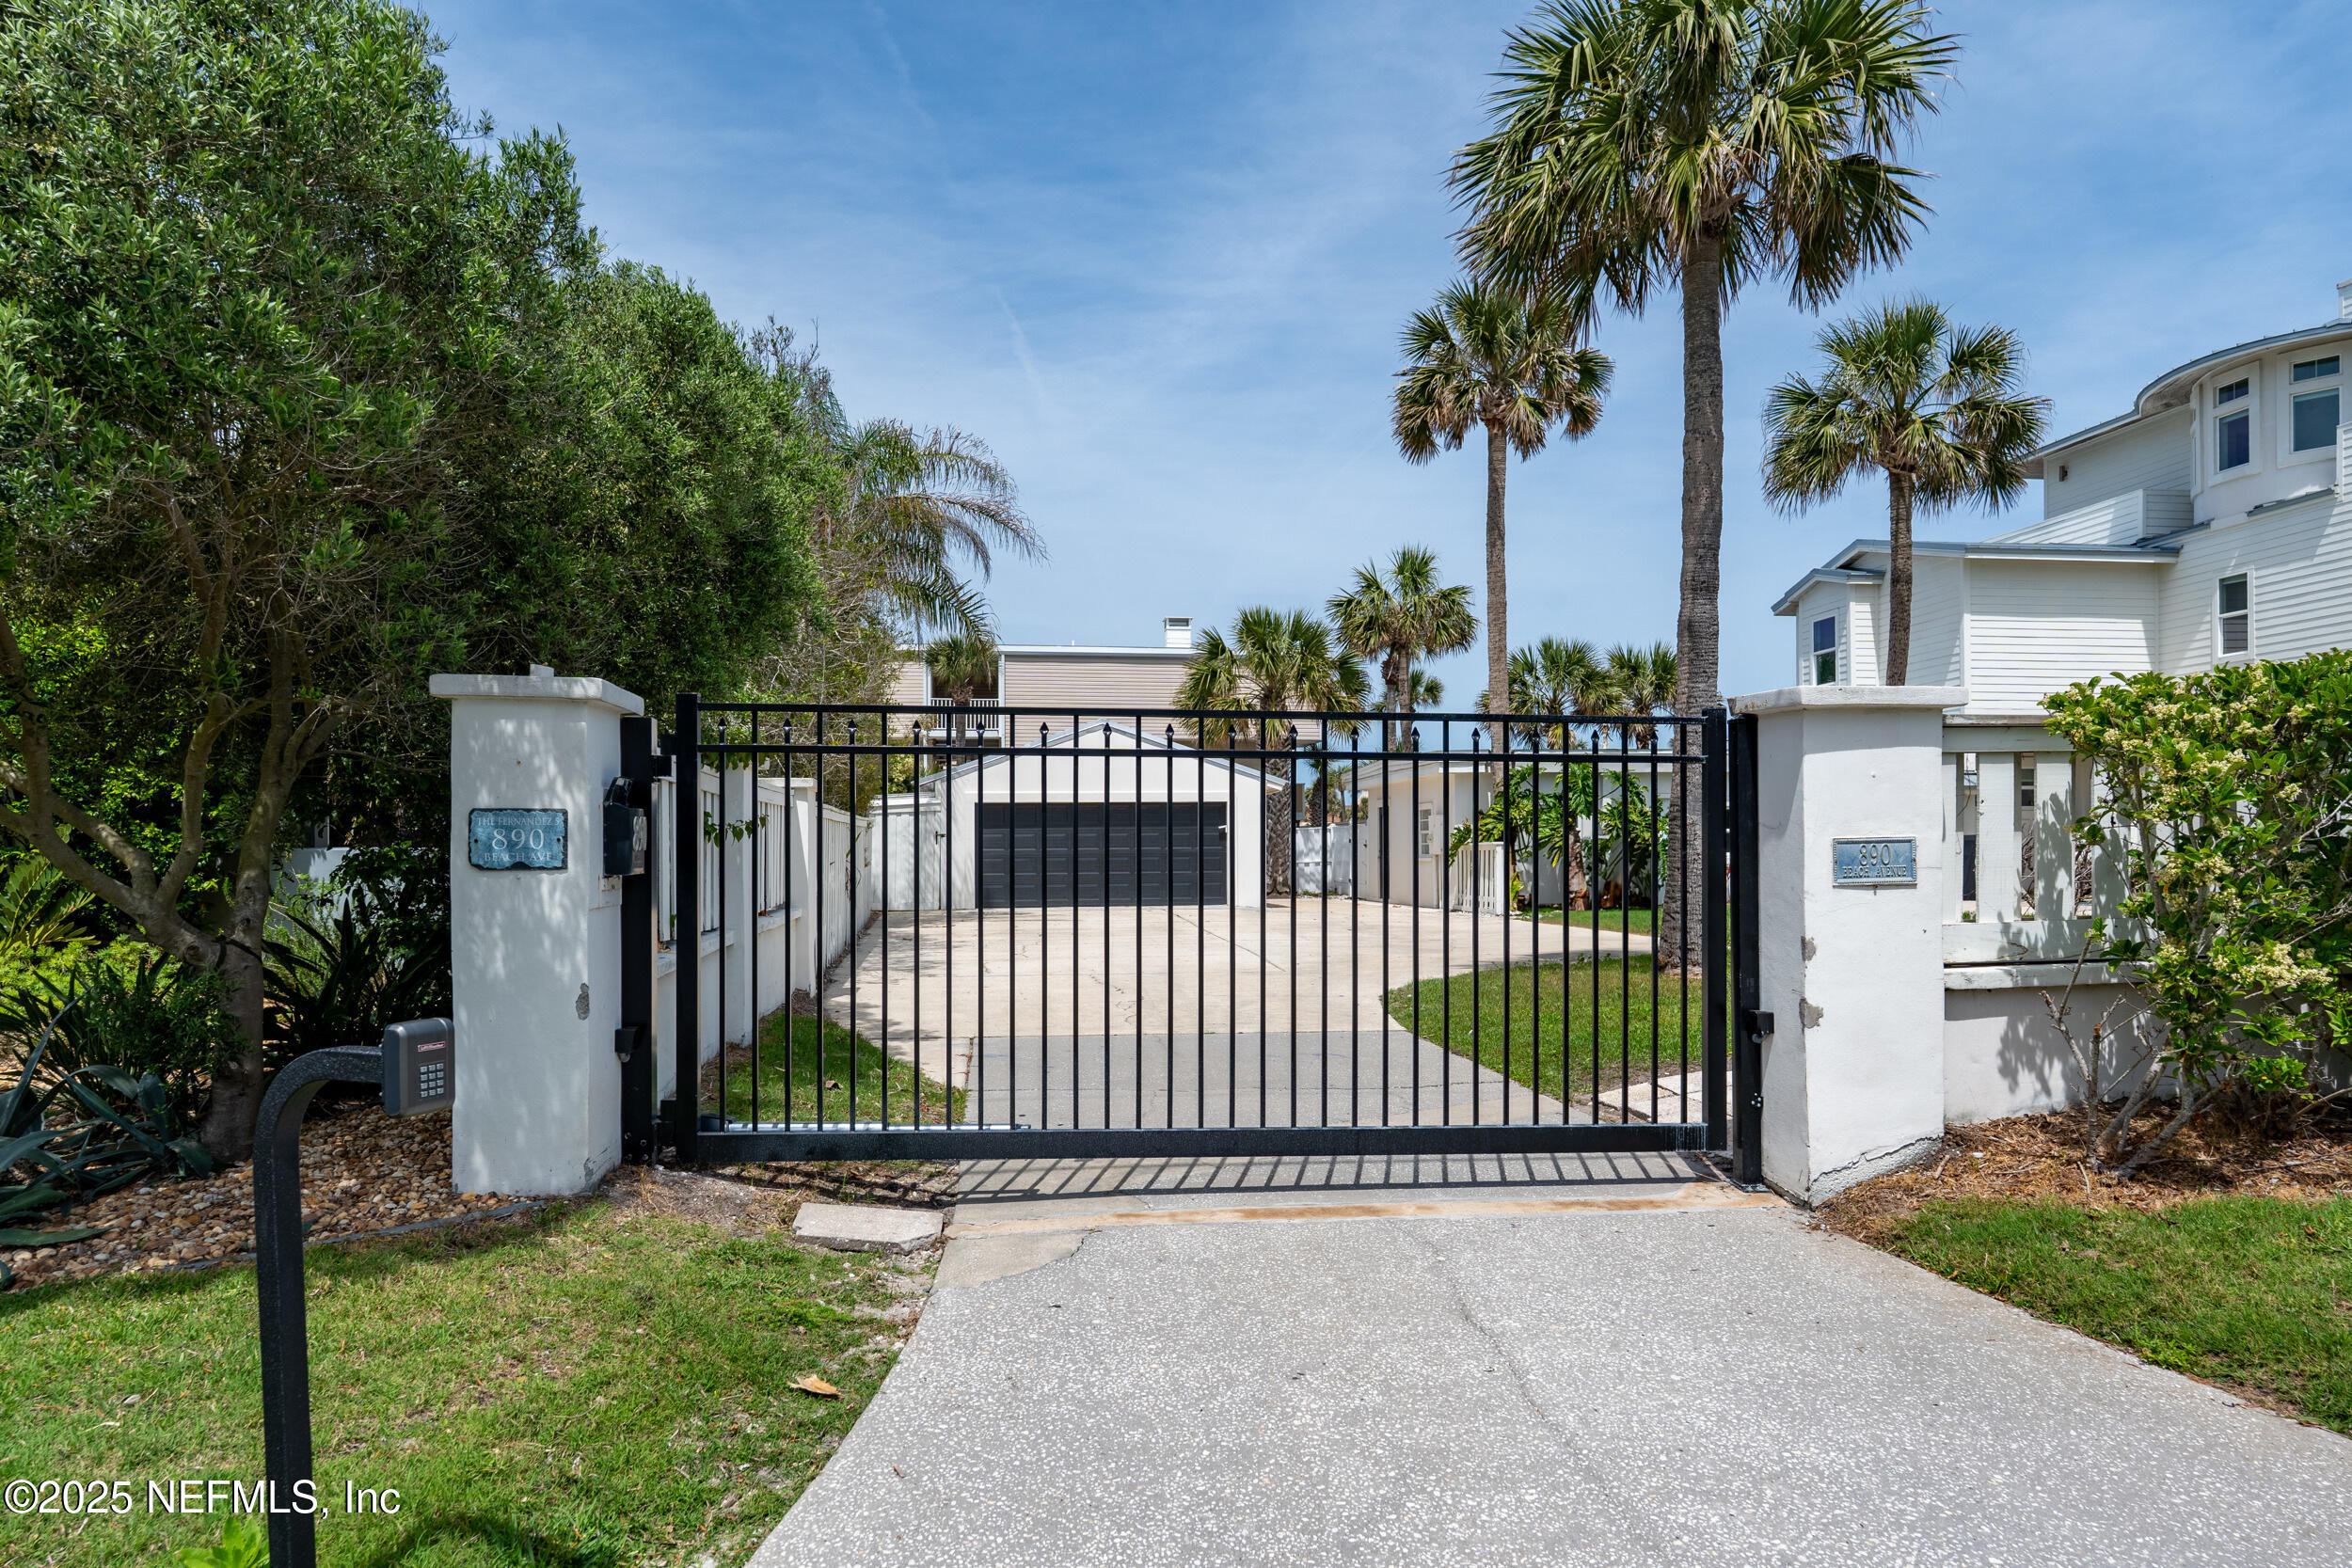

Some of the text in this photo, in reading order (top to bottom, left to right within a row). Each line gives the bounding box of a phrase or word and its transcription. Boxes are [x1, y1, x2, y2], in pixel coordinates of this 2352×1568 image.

[477, 817, 495, 826] THE
[492, 828, 545, 850] 890
[485, 853, 525, 862] BEACH
[1859, 843, 1891, 866] 890
[1842, 864, 1907, 879] BEACH AVENUE
